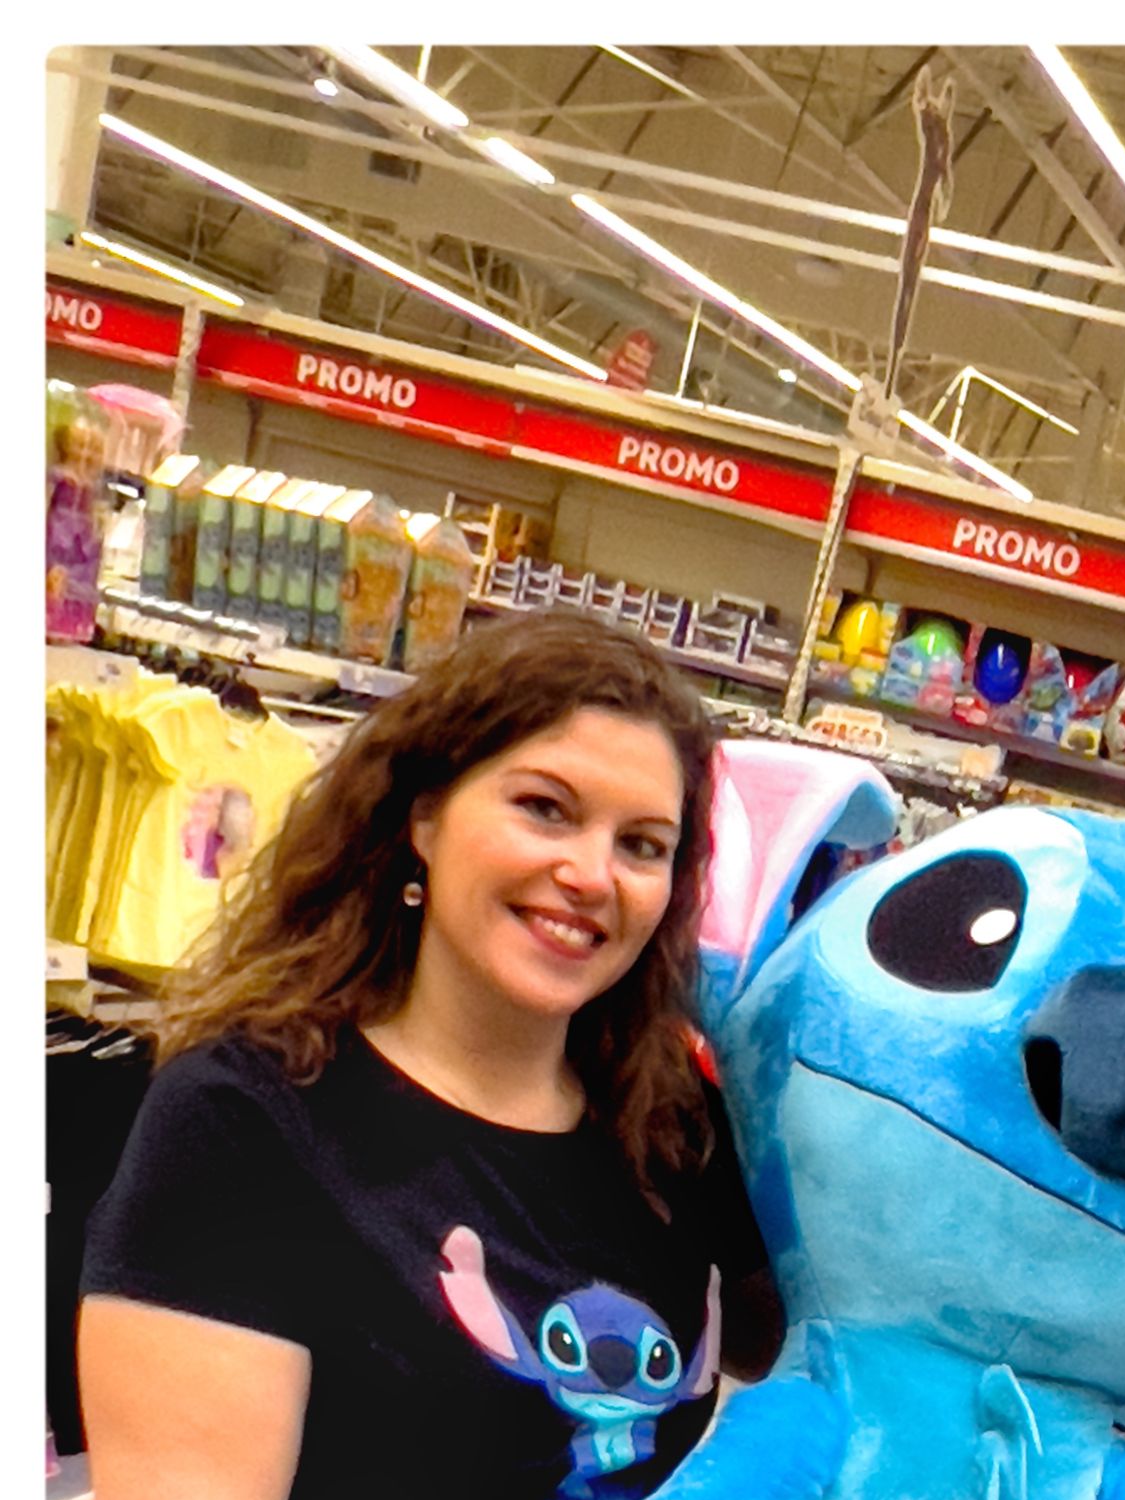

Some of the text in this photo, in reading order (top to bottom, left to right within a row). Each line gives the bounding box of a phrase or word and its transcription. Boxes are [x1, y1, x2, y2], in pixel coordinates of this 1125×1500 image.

[297, 354, 417, 409] PROMO
[618, 436, 740, 491] PROMO
[953, 518, 1081, 577] PROMO
